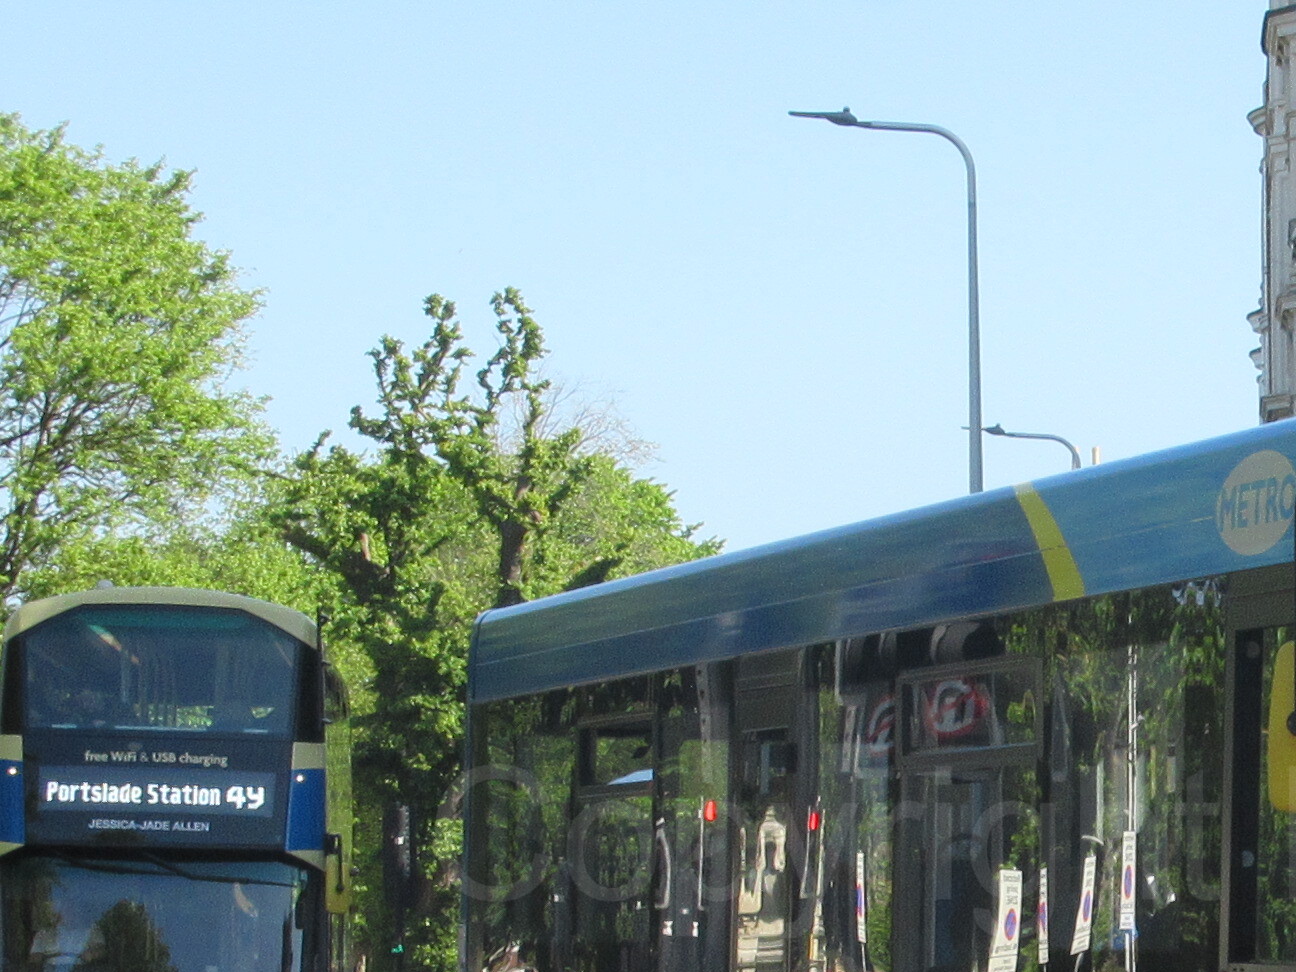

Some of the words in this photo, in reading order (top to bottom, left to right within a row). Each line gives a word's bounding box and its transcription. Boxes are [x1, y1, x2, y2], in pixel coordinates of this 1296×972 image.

[84, 750, 108, 762] free
[110, 751, 137, 762] WiFi
[152, 752, 177, 763] USB
[179, 752, 229, 768] charging
[46, 781, 142, 804] Portslade
[147, 783, 221, 806] Station
[88, 819, 171, 832] JESSICA-JADE
[172, 821, 211, 833] ALLEN
